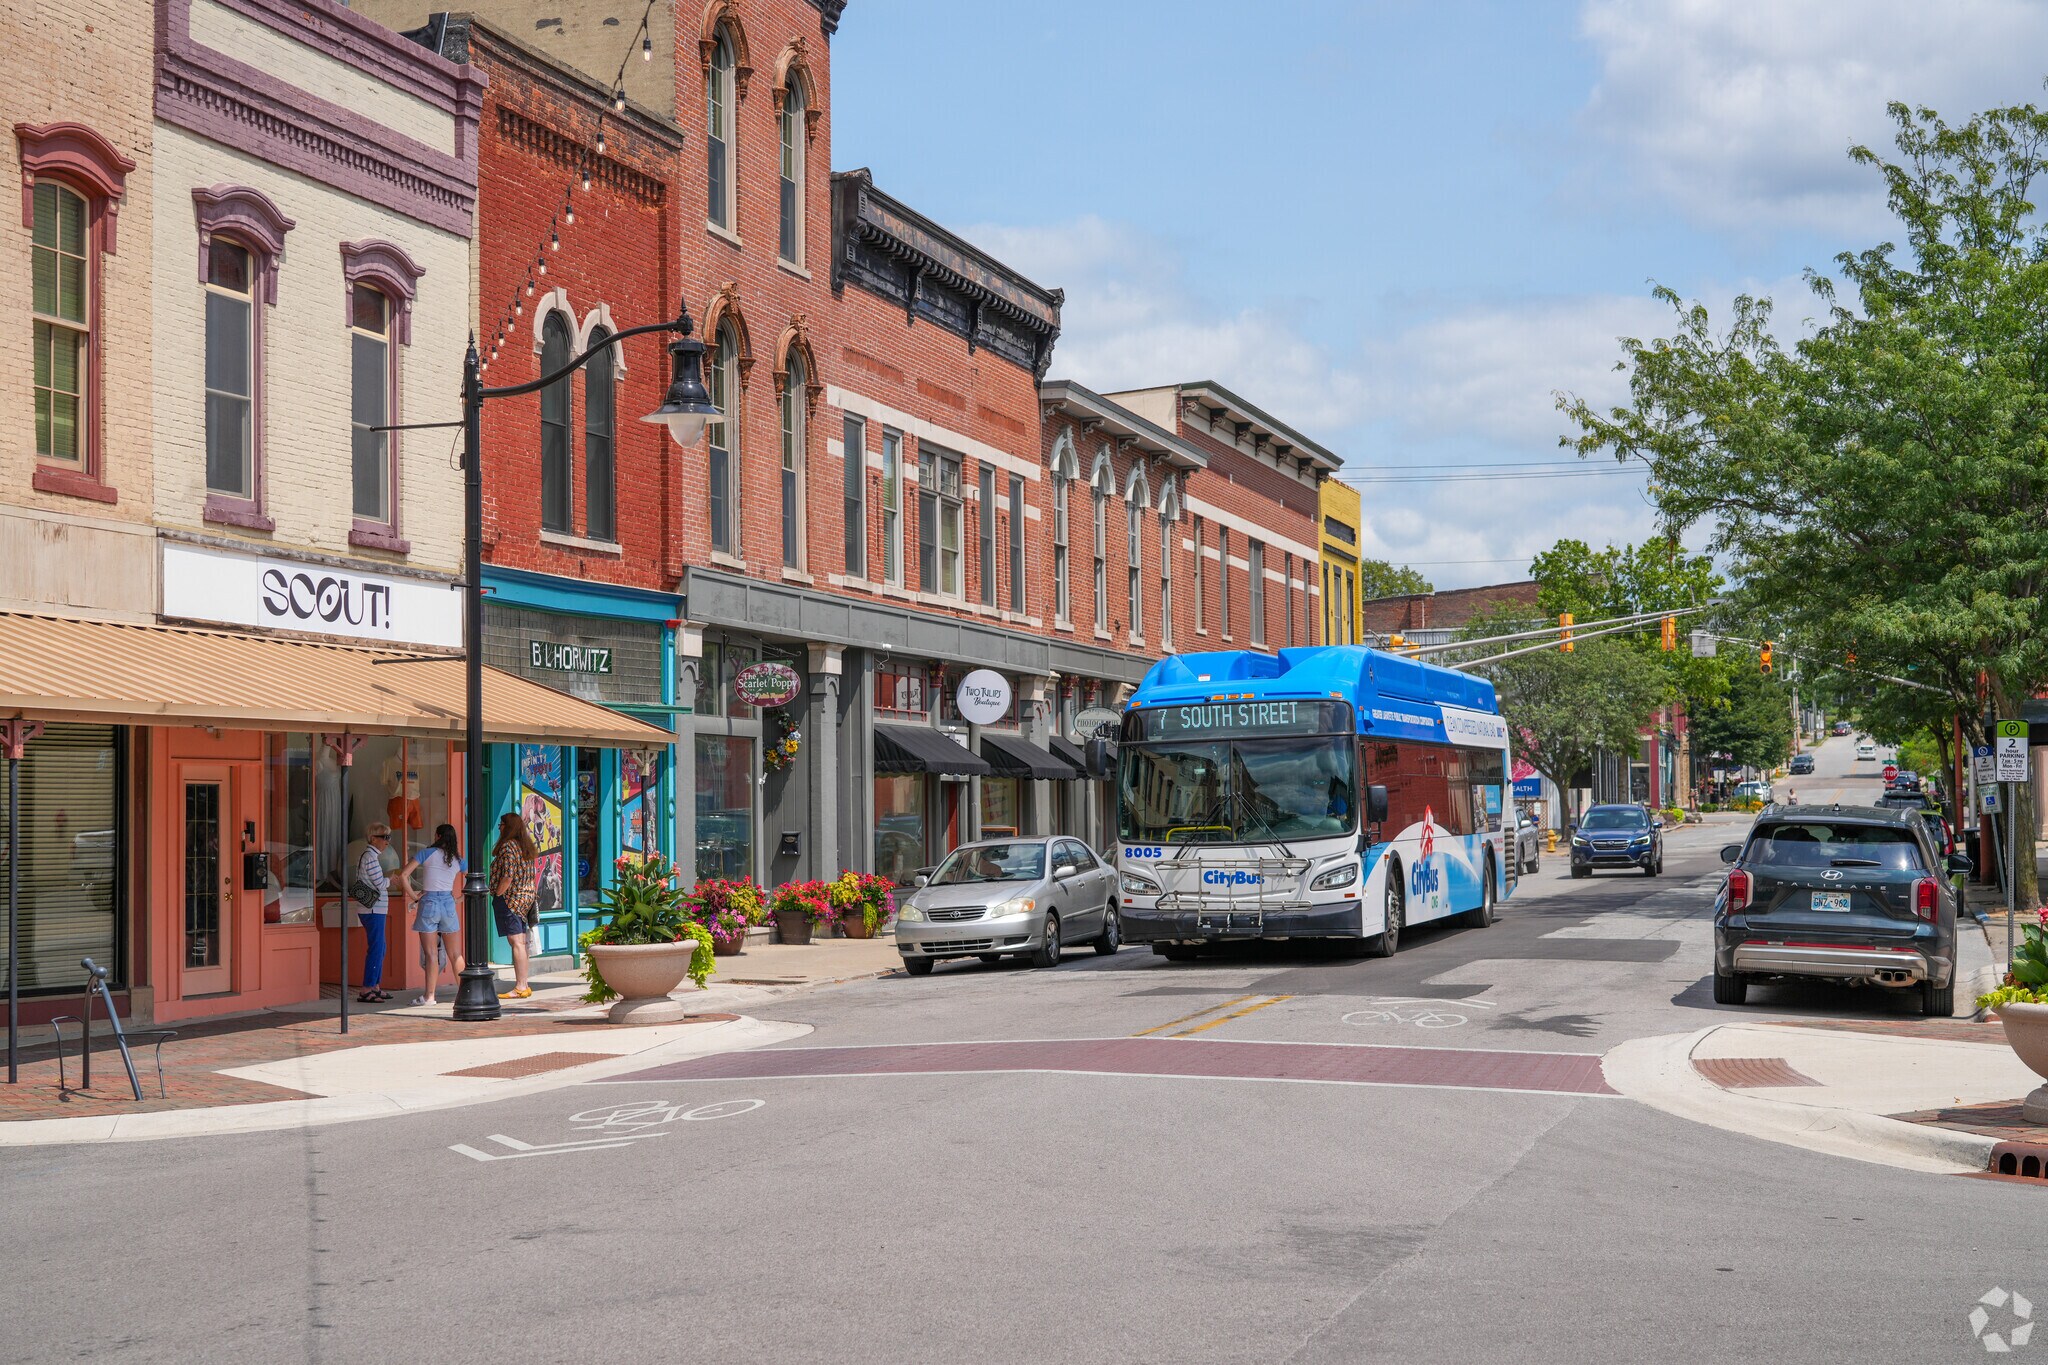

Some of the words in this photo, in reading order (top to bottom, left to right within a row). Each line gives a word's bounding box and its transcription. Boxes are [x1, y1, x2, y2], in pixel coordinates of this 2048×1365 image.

[262, 569, 390, 629] SCOUT!
[532, 642, 541, 666] B
[545, 644, 552, 667] L
[554, 645, 609, 672] HORWITZ
[738, 678, 768, 688] Scarlet
[771, 678, 798, 690] Poppy
[1157, 708, 1167, 730] 7
[1181, 705, 1233, 729] SOUTH
[1238, 701, 1298, 726] STREET
[2008, 738, 2016, 748] 2
[1125, 847, 1162, 858] 8005
[1203, 869, 1265, 888] CityBus
[1412, 860, 1439, 904] CityBus
[1777, 881, 1887, 891] PALISADE
